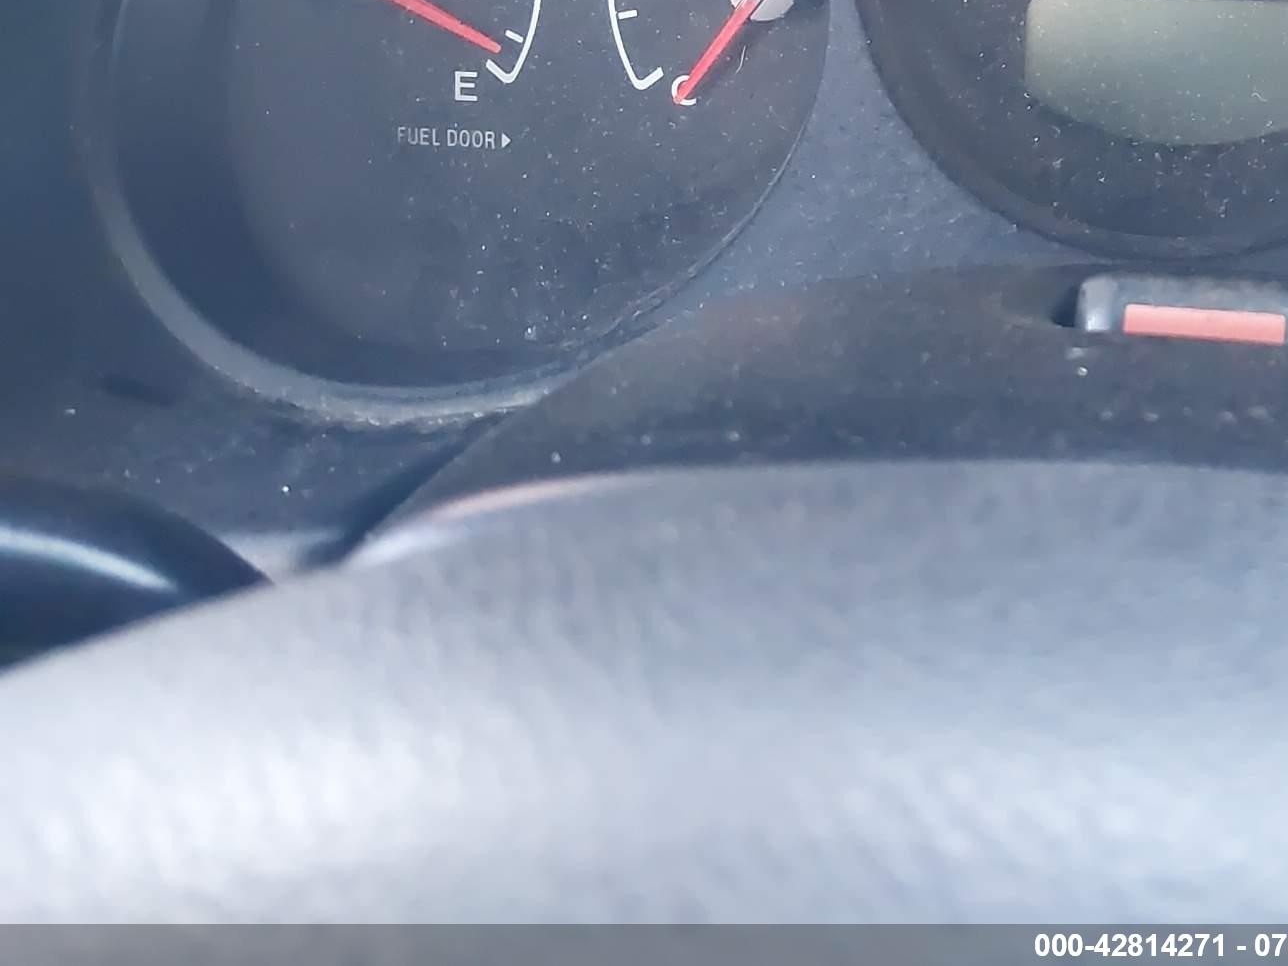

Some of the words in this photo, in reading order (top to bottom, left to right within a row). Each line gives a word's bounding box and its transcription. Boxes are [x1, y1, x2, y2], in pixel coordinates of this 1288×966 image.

[455, 71, 478, 102] E
[397, 127, 440, 146] FUEL
[447, 130, 495, 149] DOOR
